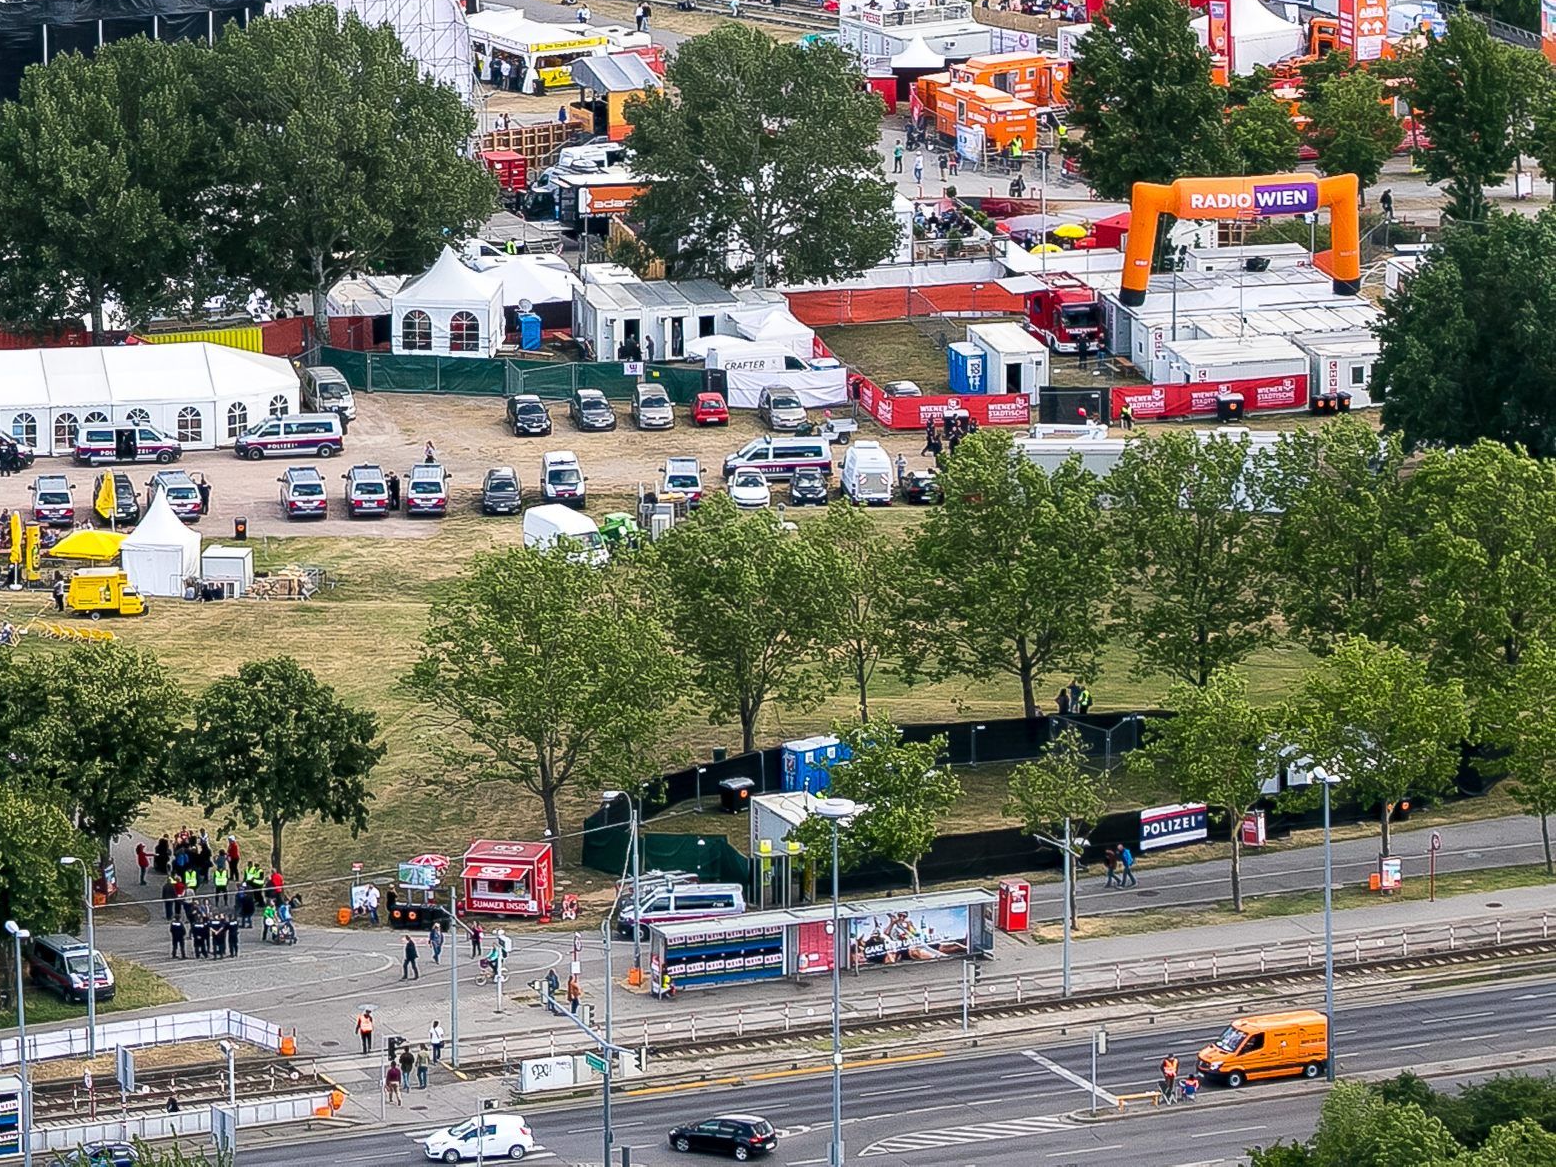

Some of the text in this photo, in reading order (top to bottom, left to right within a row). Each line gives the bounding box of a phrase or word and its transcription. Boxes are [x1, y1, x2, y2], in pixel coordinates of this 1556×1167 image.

[1190, 189, 1308, 209] RADIO WIEN
[724, 360, 766, 371] CRAFTER
[1143, 815, 1196, 837] POLIZEI
[472, 900, 505, 910] SUMMER
